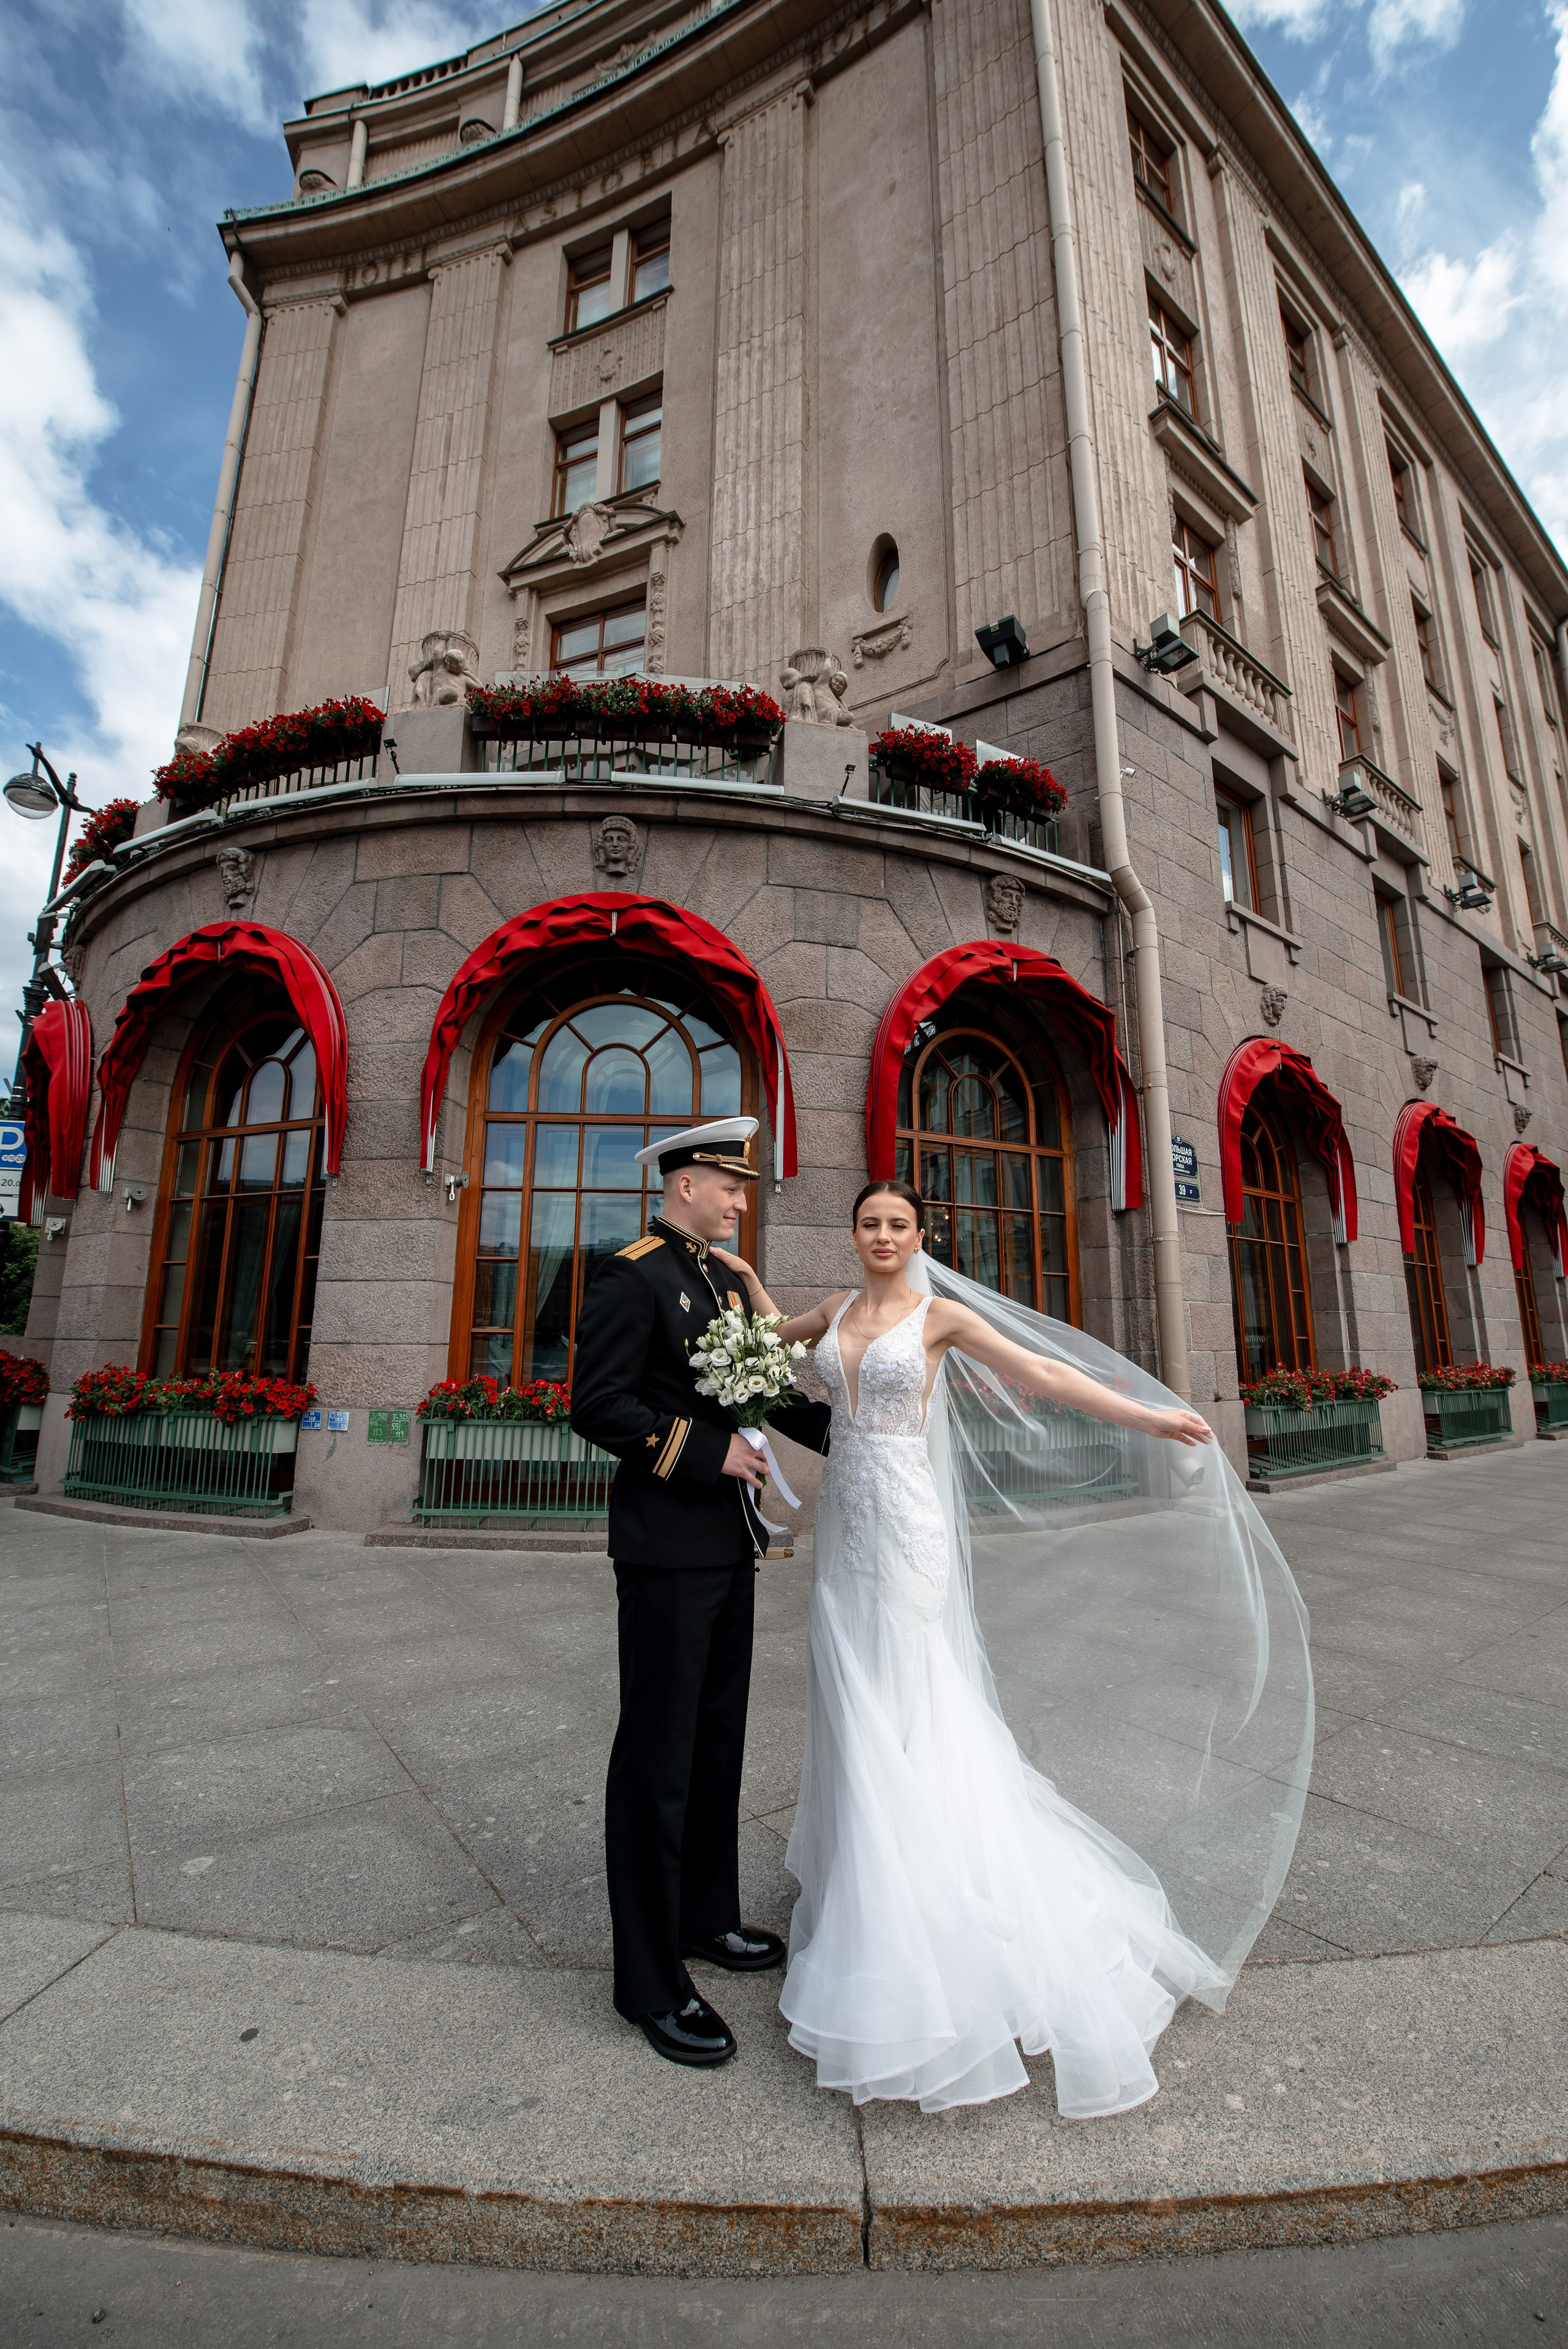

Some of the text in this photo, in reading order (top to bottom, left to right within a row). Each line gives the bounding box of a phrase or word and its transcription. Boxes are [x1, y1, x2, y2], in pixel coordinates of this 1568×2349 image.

[344, 247, 428, 288] HOTEL
[512, 118, 716, 238] ASTORIA
[0, 1126, 24, 1150] P
[1171, 1144, 1192, 1156] ОЛЬШАЯ
[1172, 1153, 1192, 1165] ОРСКАЯ
[1178, 1184, 1185, 1195] 39
